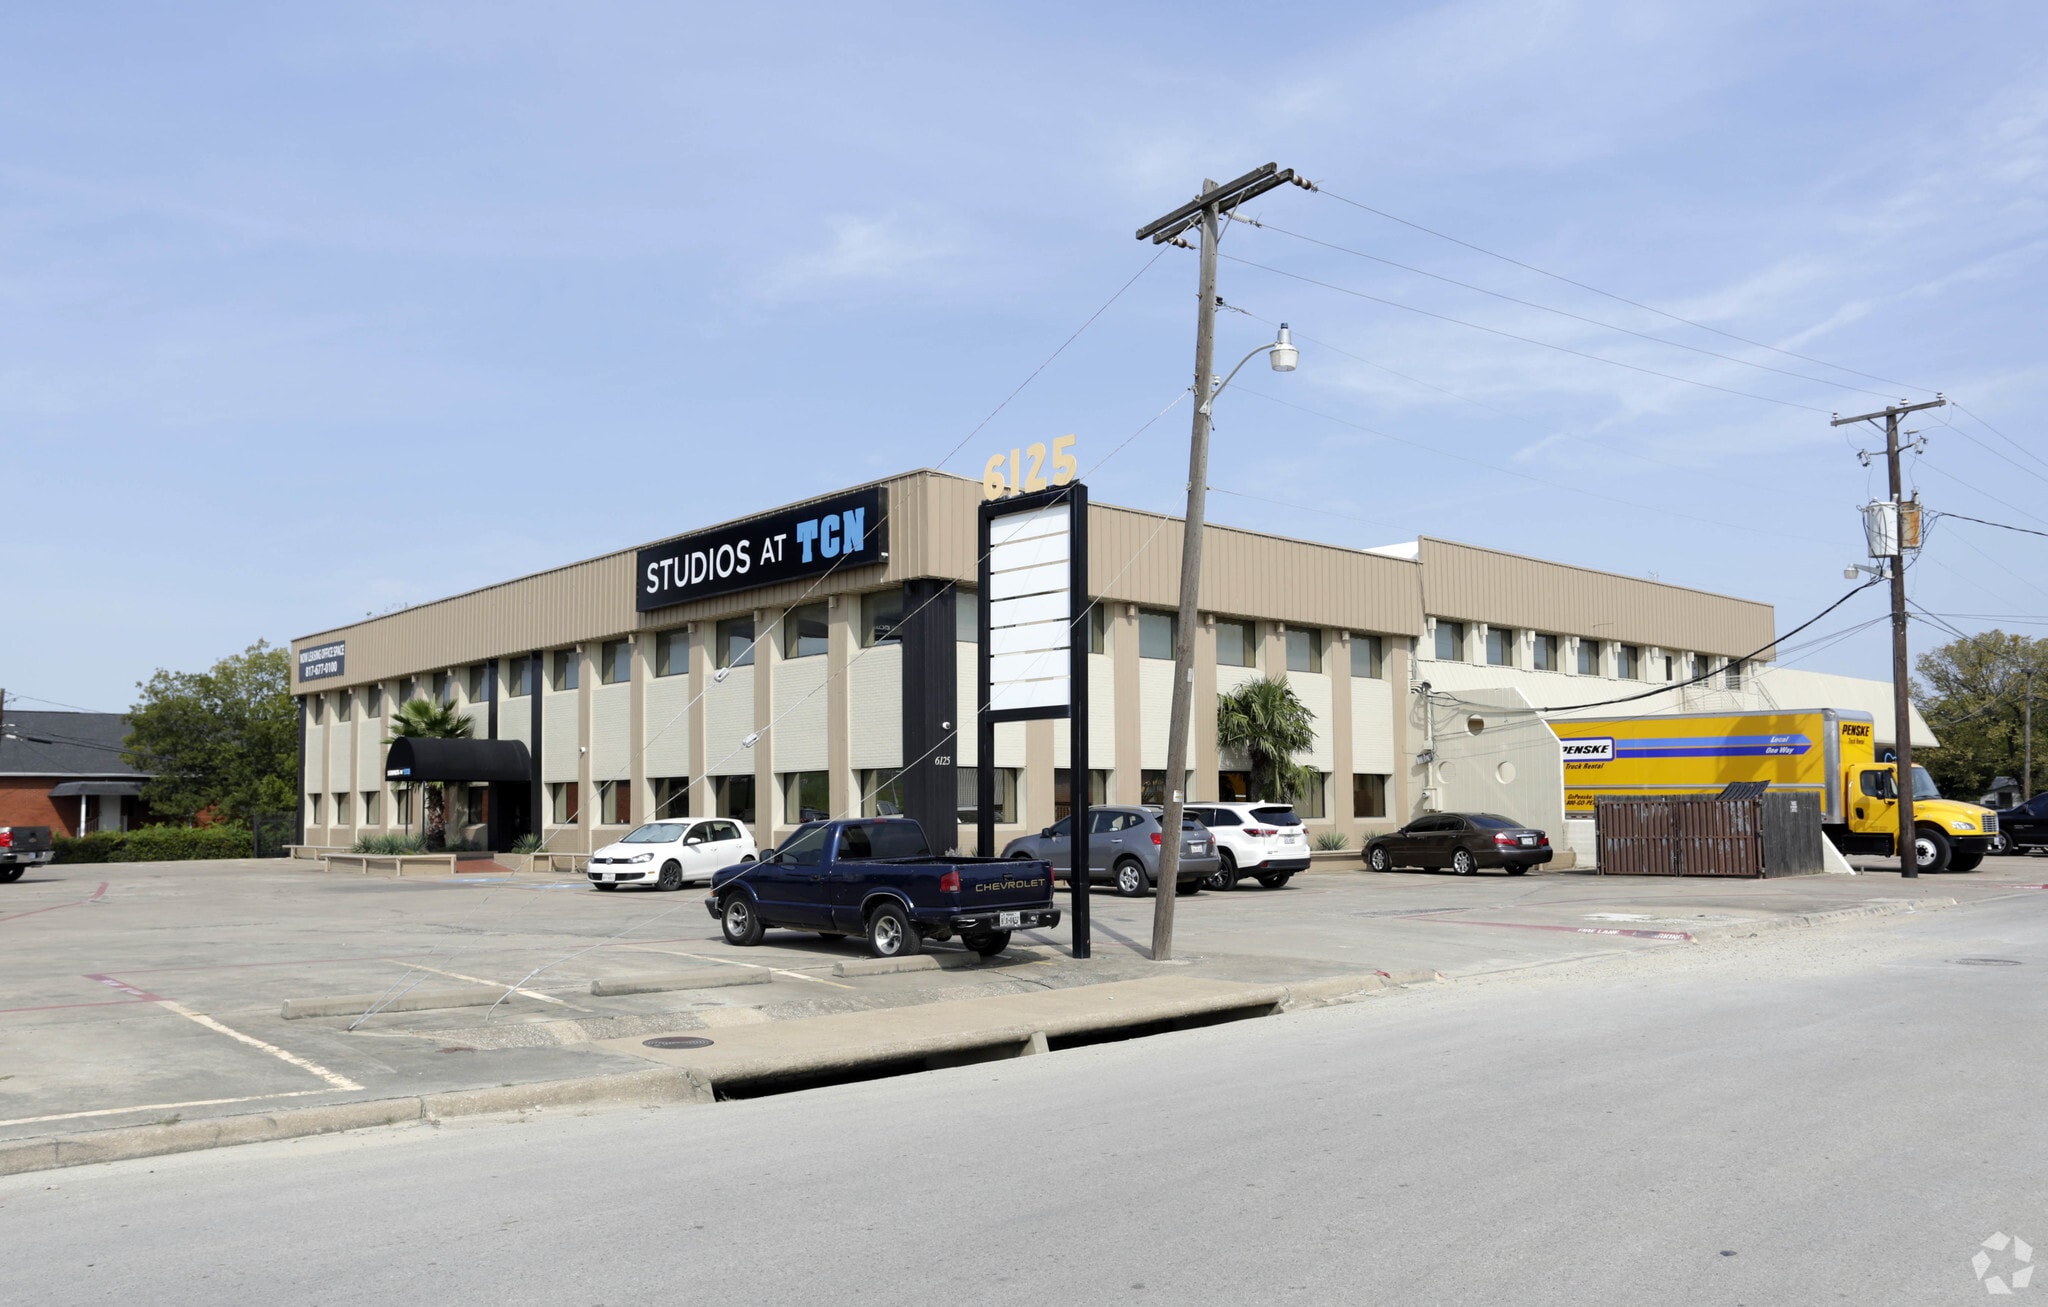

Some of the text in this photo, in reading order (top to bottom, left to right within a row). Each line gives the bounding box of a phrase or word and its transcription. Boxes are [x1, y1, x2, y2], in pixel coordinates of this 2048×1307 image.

[984, 433, 1077, 501] 6125
[646, 507, 865, 594] STUDIOS AT TCN
[308, 649, 321, 662] LEASING
[321, 647, 334, 659] OFFICE
[334, 644, 344, 657] SPACE
[305, 661, 338, 677] 817-677-0100
[1842, 724, 1870, 737] PENSKE
[1779, 746, 1794, 755] Way
[934, 756, 951, 766] 6125
[975, 879, 1046, 892] CHEVROLET
